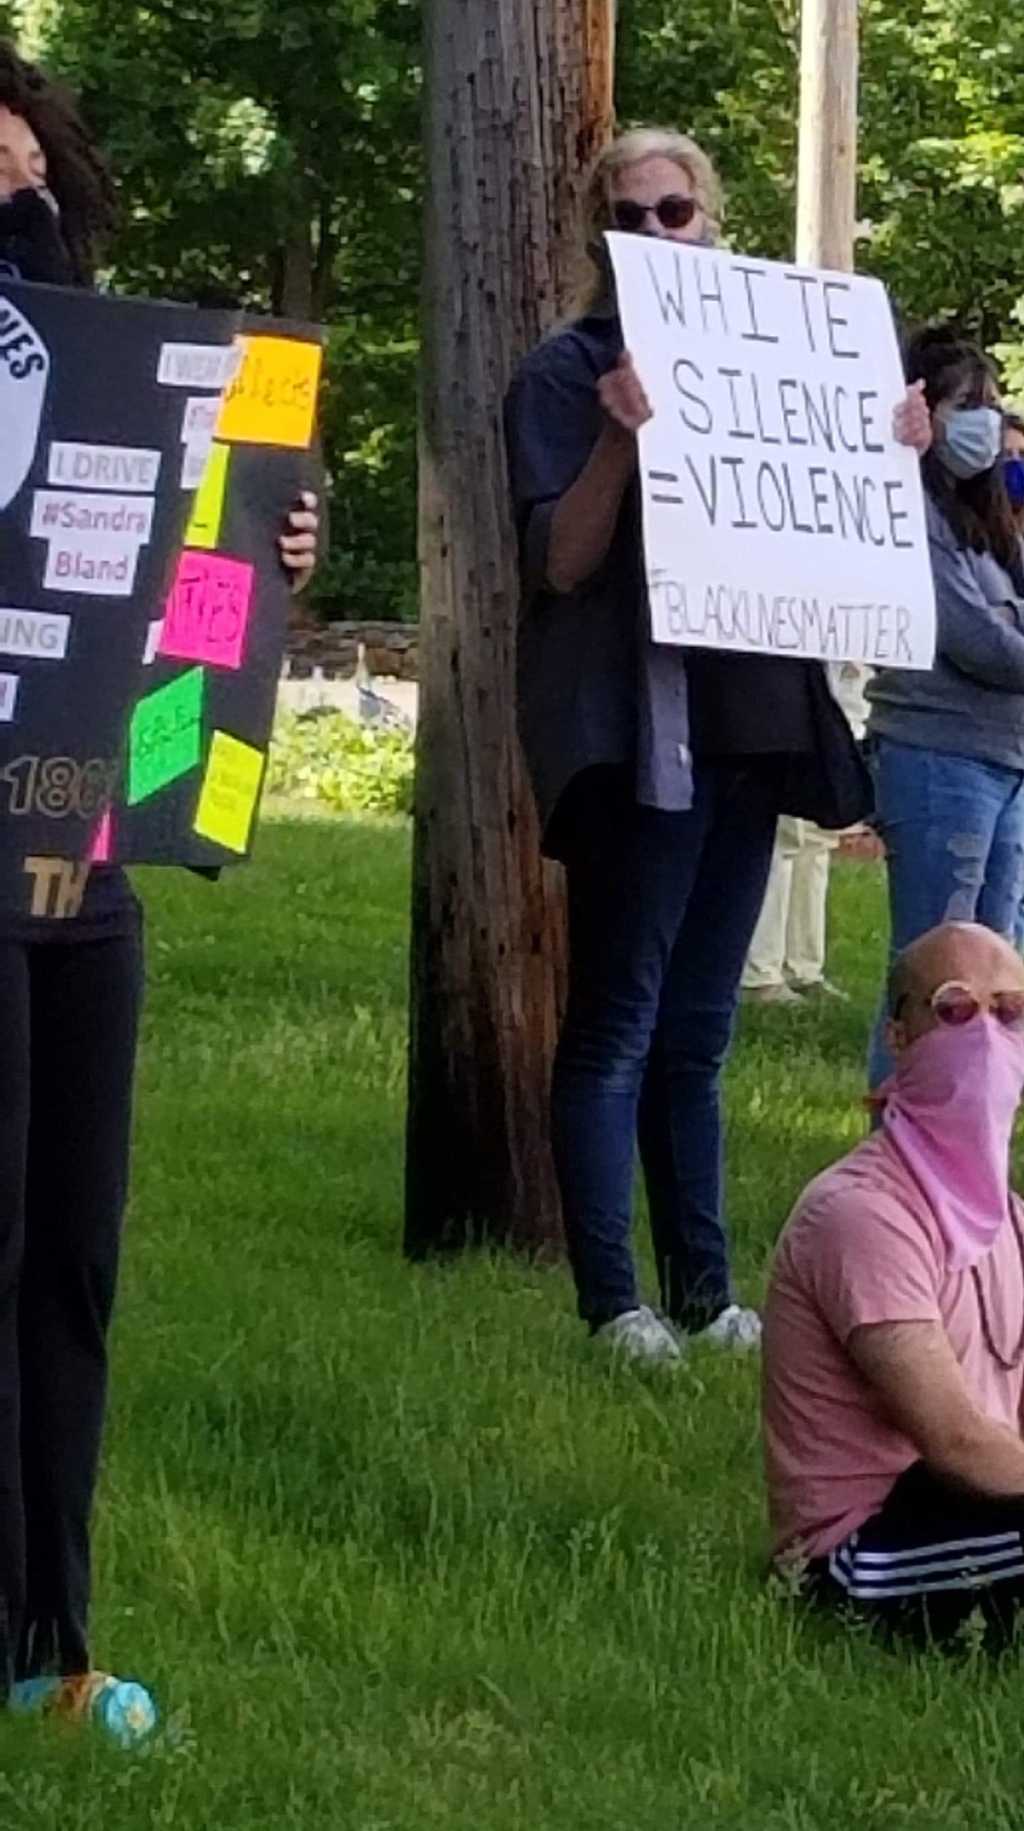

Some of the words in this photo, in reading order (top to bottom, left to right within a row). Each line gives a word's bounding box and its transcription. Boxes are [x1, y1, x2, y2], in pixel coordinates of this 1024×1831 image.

[647, 251, 860, 359] WHITE
[672, 358, 885, 453] SILENCE
[55, 451, 64, 477] I
[73, 452, 153, 484] DRIVE
[42, 502, 146, 535] #Sandra
[648, 454, 914, 549] =VIOLENCE
[55, 551, 129, 581] Bland
[0, 617, 59, 651] ING
